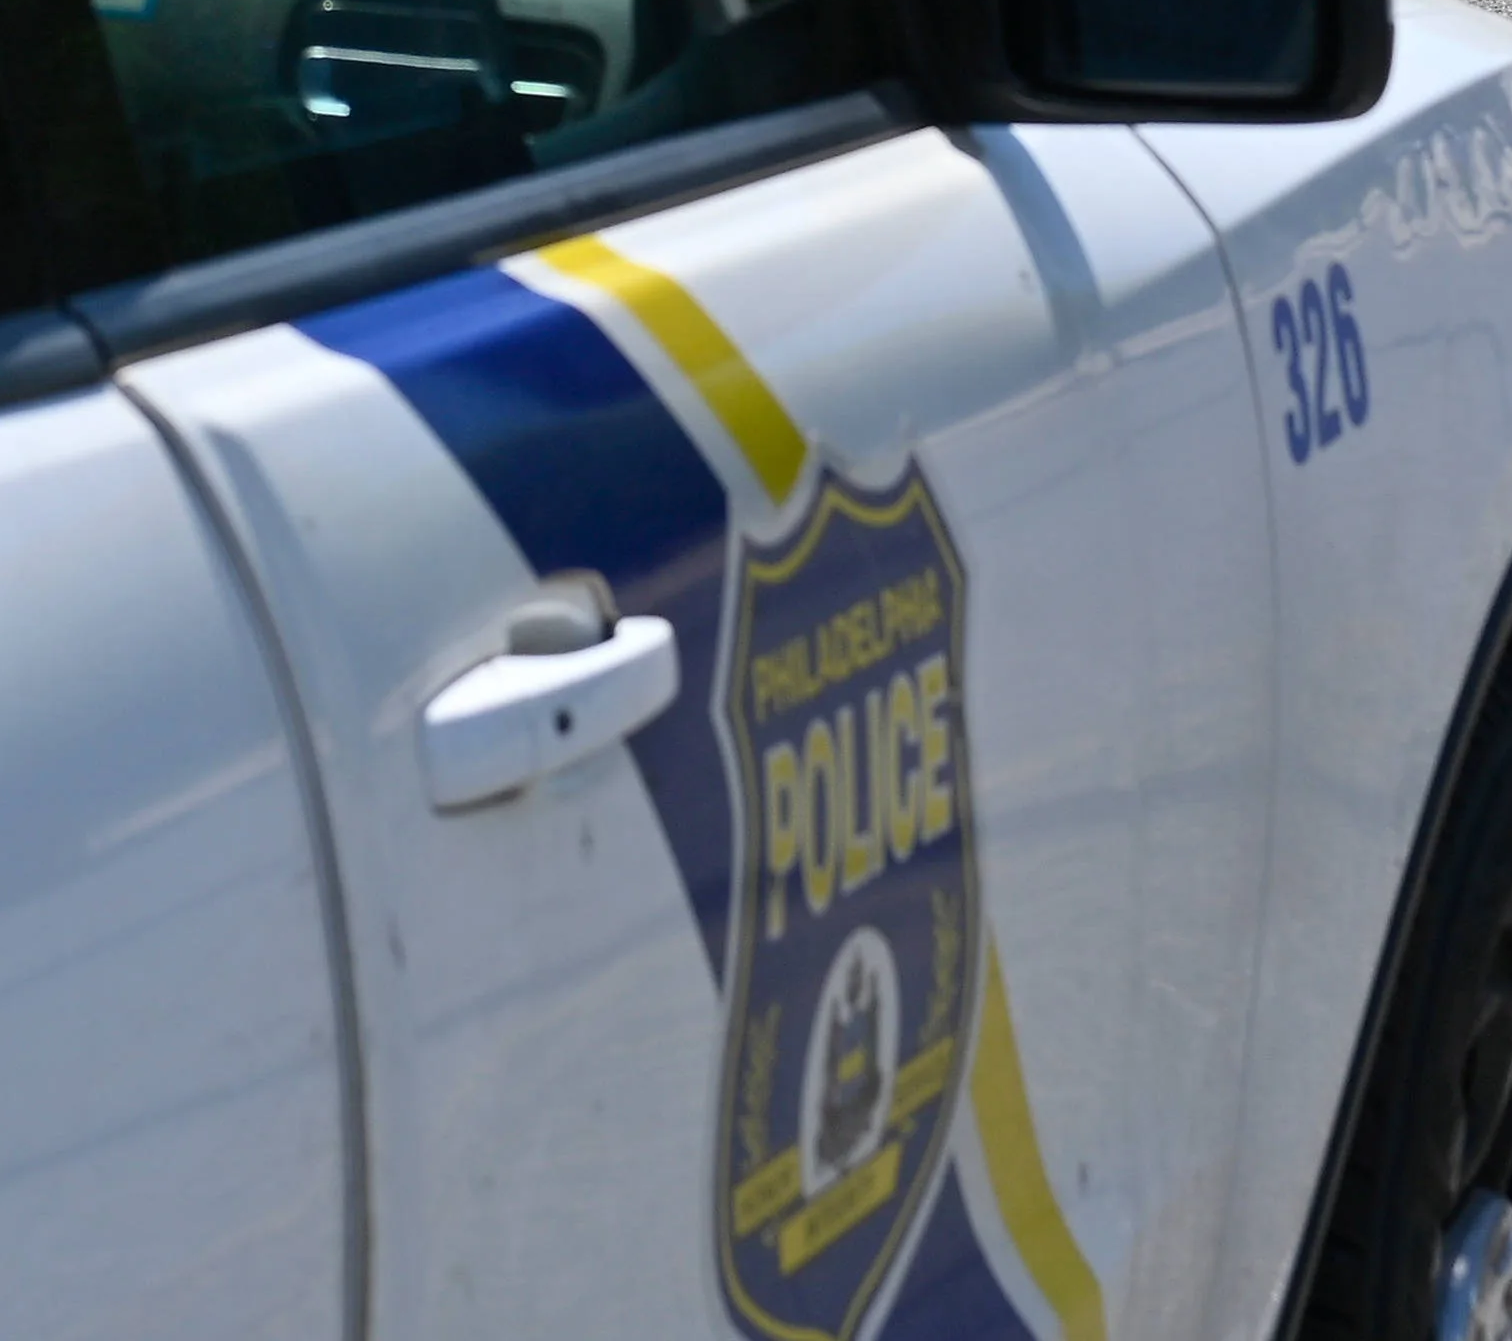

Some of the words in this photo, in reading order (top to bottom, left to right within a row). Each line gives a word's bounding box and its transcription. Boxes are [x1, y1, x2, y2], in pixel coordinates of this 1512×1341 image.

[1270, 261, 1370, 467] 326
[753, 566, 943, 724] PHILADELPHIA
[763, 650, 954, 941] POLICE
